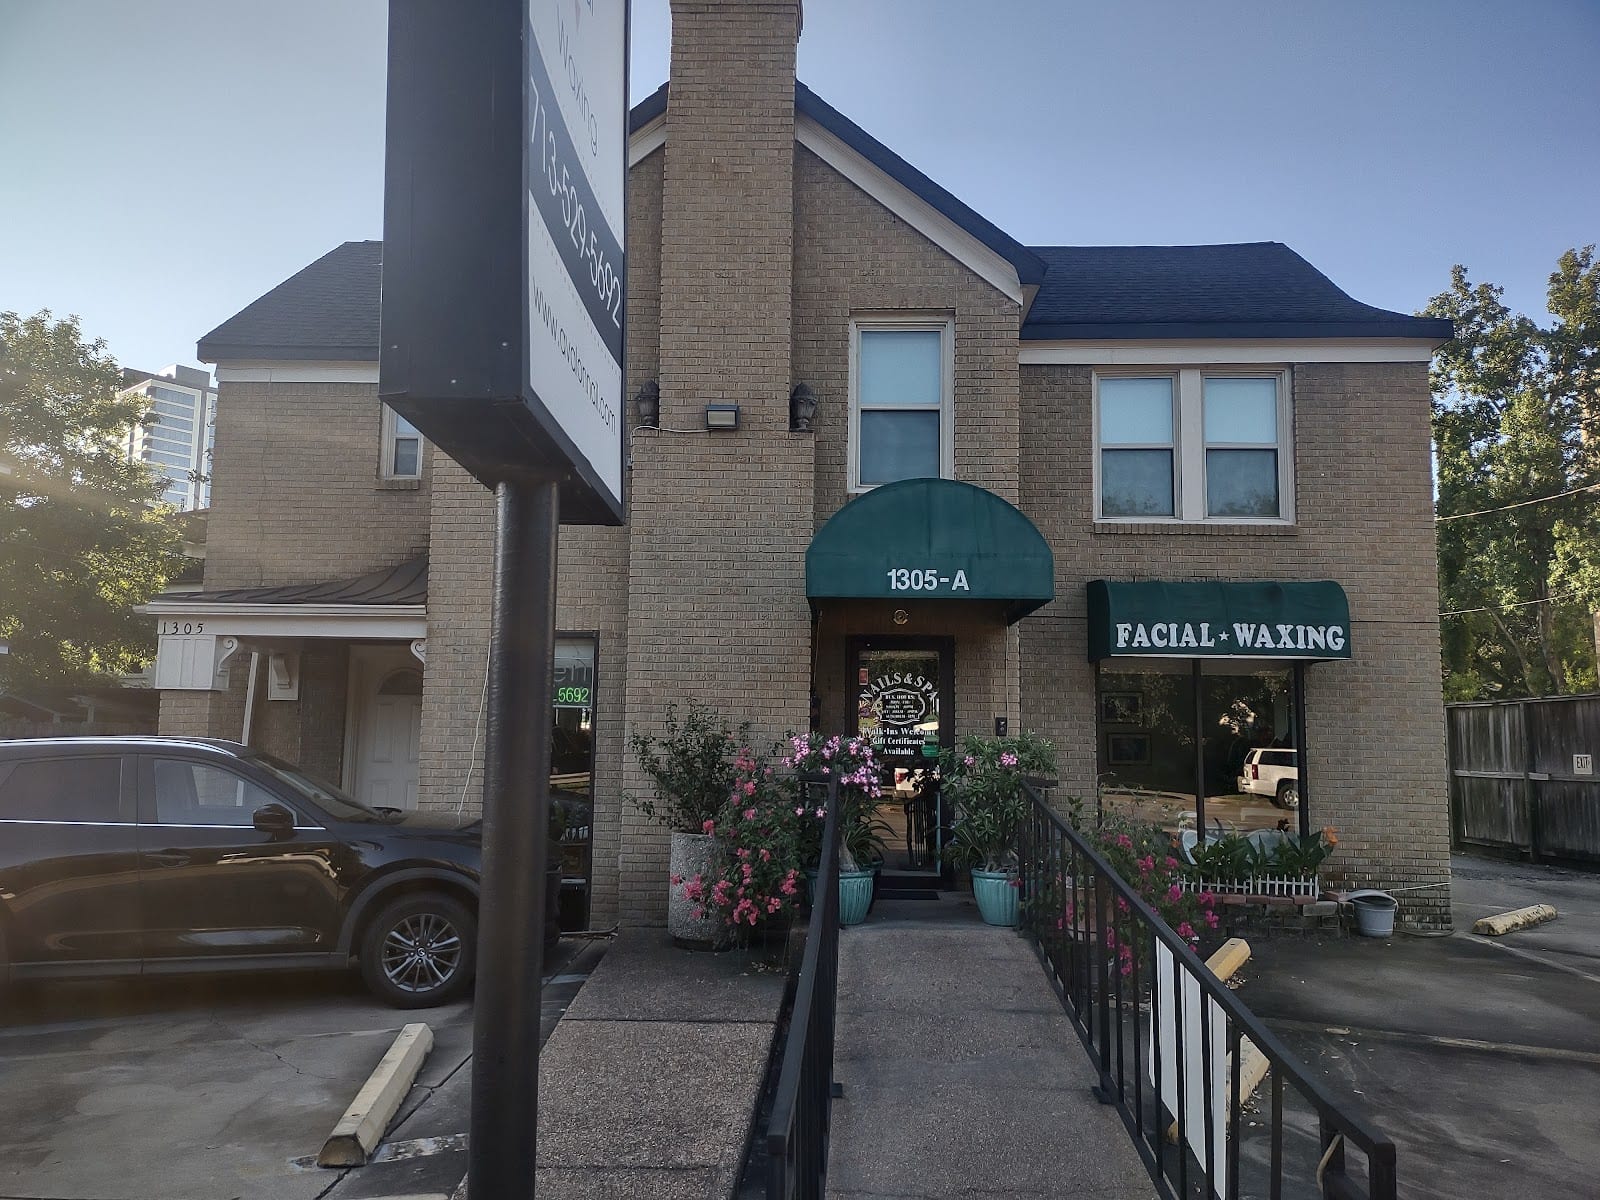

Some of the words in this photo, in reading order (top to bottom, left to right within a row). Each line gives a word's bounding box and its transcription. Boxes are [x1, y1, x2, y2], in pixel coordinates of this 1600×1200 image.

[556, 3, 598, 157] Waxing
[530, 75, 621, 329] 713-529-5692
[887, 568, 970, 591] 1305-A
[162, 621, 204, 635] 1305
[1116, 622, 1215, 648] FACIAL
[1232, 623, 1345, 651] WAXING
[558, 687, 589, 703] 5692
[872, 736, 886, 745] Gift
[888, 736, 926, 745] Certificates
[883, 748, 914, 756] Available
